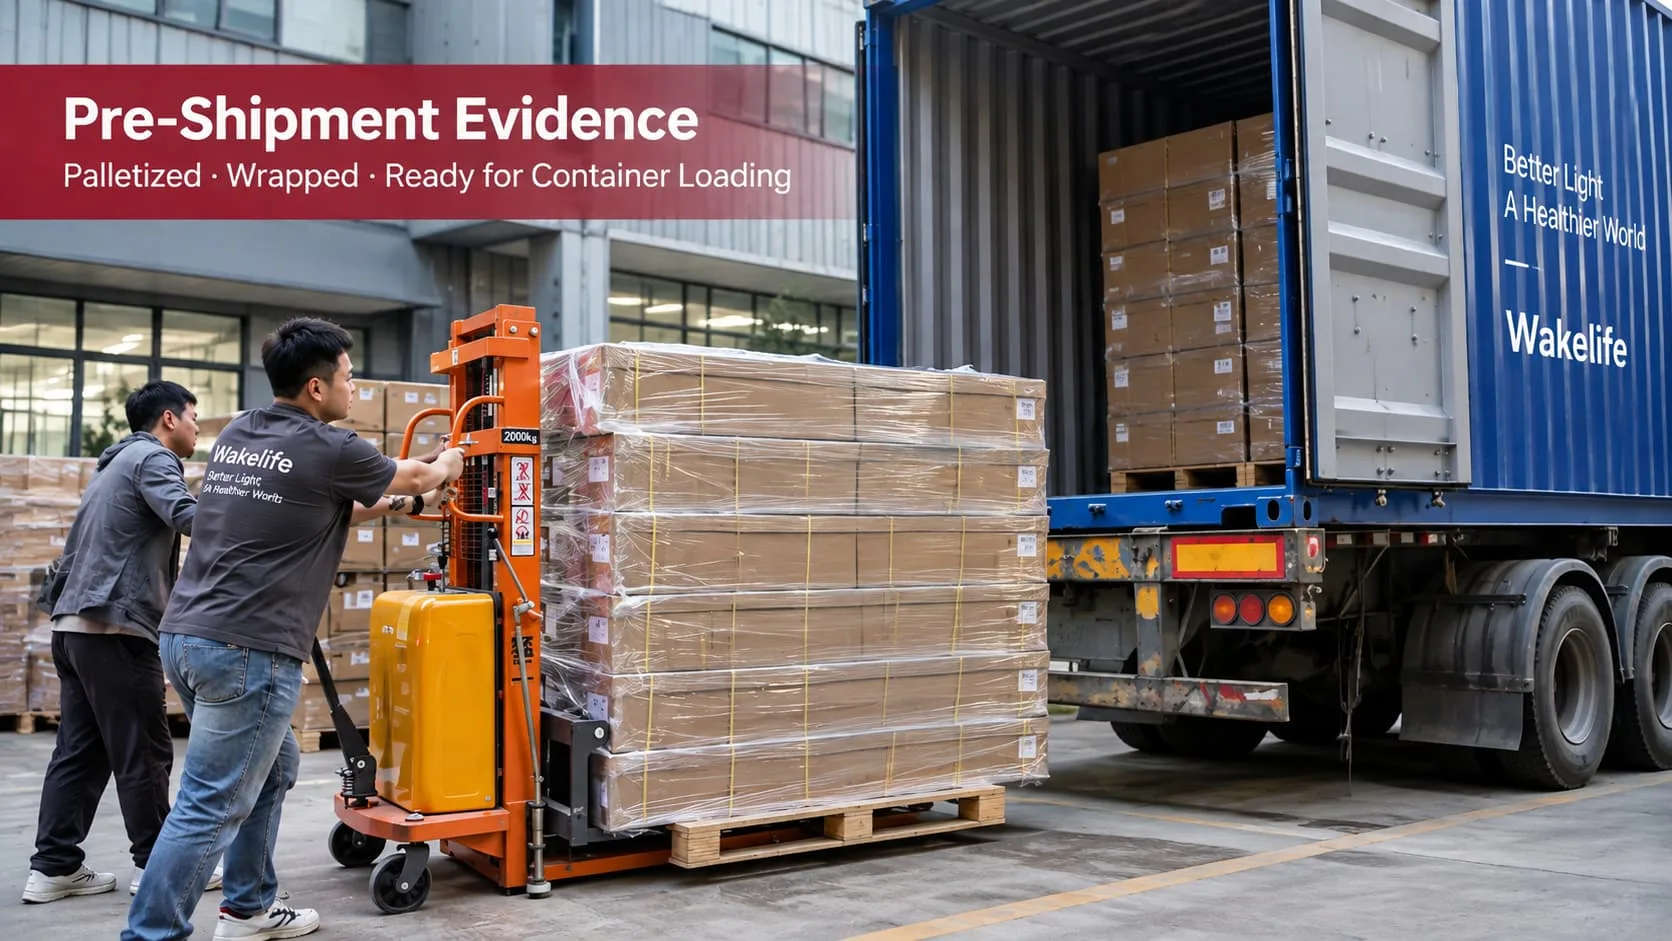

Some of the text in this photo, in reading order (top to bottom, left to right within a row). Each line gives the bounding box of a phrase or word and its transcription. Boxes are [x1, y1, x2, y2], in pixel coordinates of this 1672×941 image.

[1504, 143, 1604, 201] Better Light
[1504, 190, 1647, 251] A Healthier World
[1505, 309, 1628, 368] Wakelife
[212, 444, 294, 474] Wakelife
